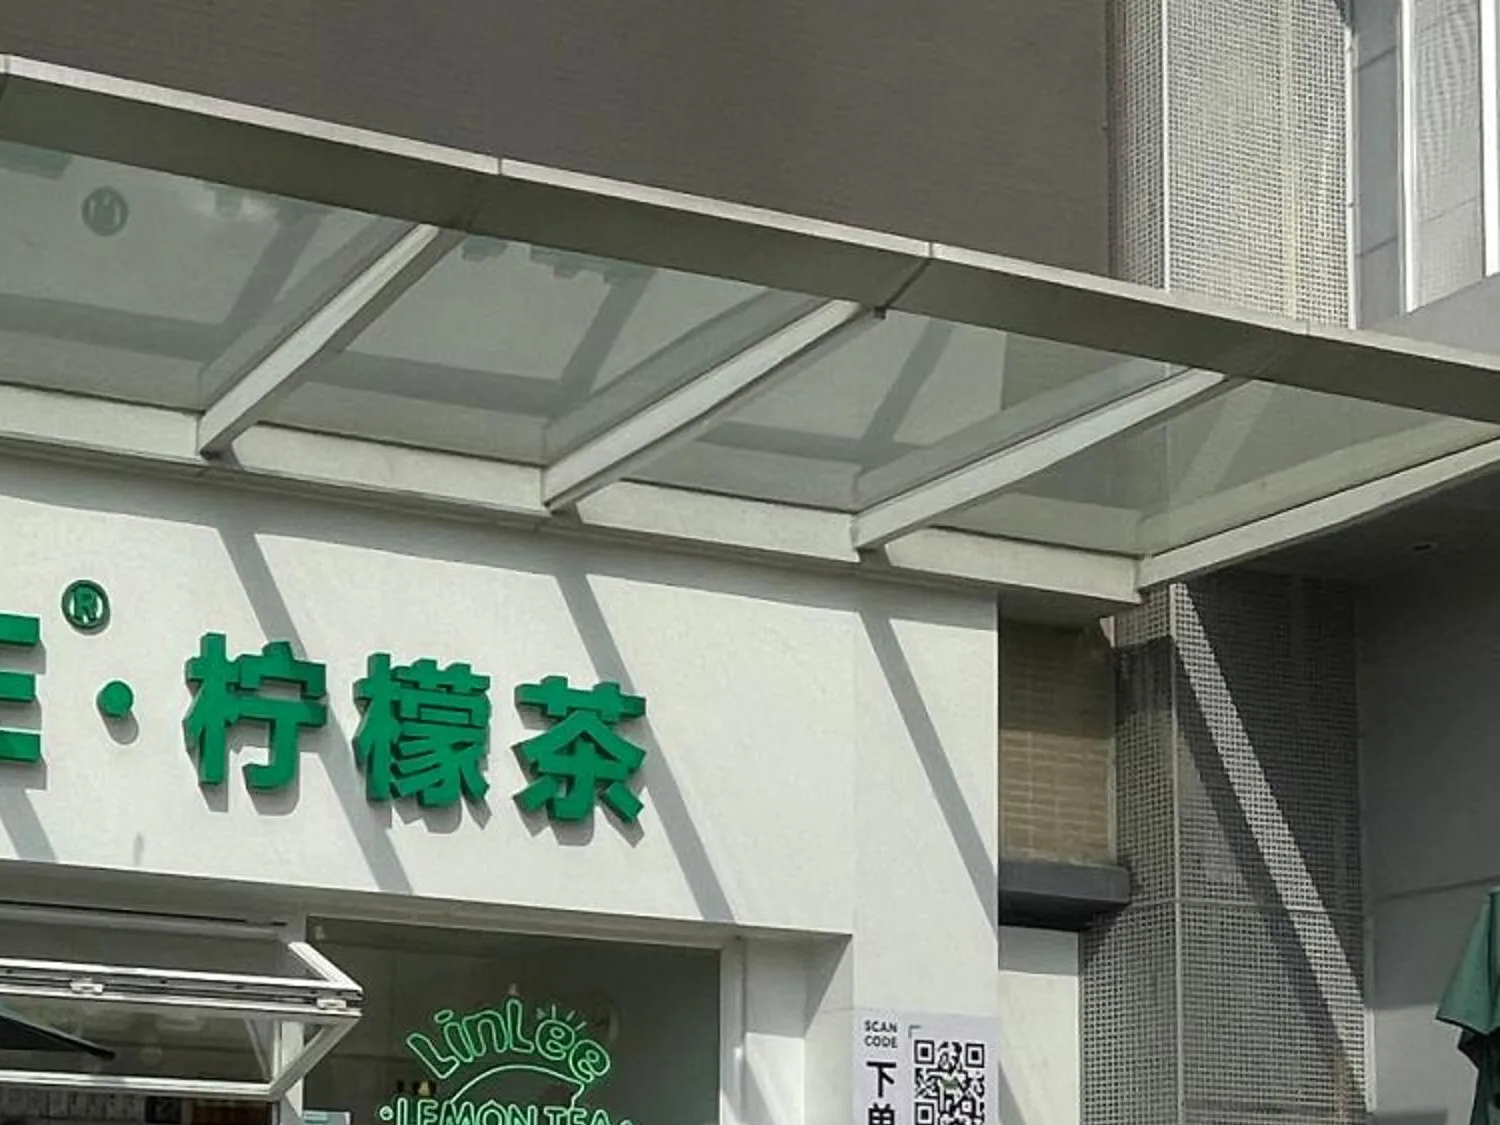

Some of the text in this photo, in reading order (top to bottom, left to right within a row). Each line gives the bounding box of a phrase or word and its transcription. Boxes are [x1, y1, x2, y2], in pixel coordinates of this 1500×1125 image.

[184, 632, 647, 824] 柠檬茶
[864, 1019, 897, 1033] SCAN
[864, 1035, 898, 1049] CODE
